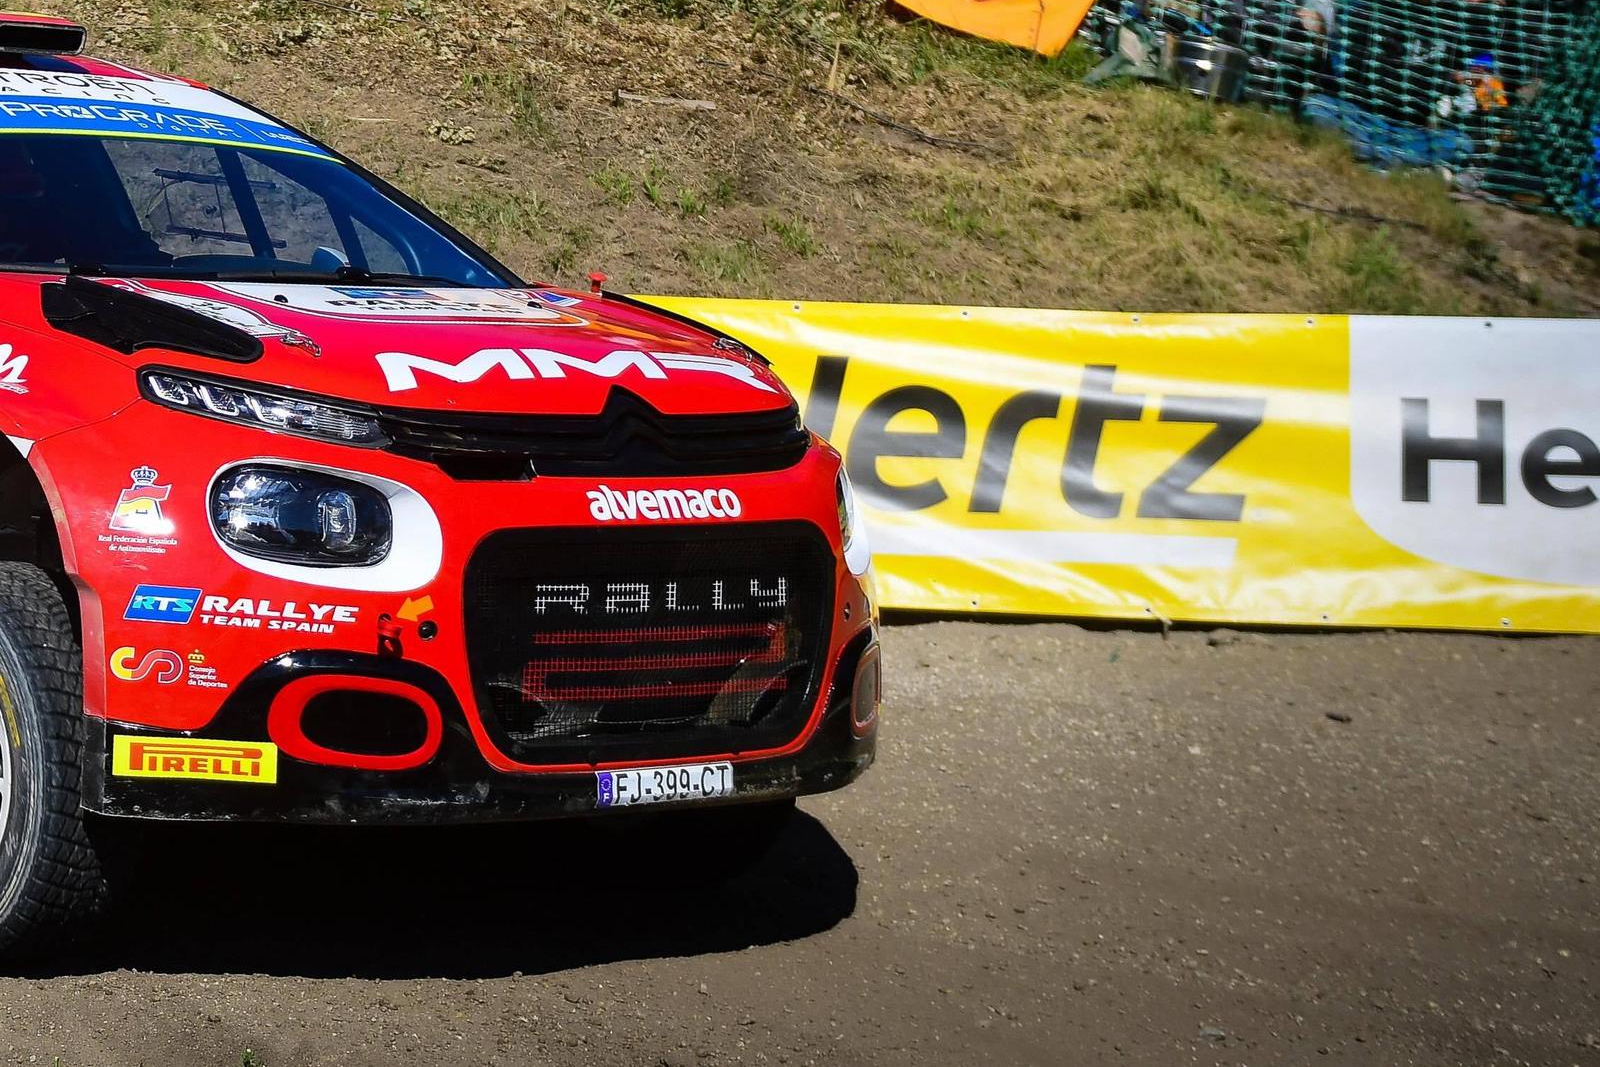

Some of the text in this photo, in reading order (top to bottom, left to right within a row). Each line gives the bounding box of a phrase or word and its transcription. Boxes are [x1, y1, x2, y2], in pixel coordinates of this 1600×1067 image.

[137, 122, 242, 139] DIGITAL
[376, 347, 779, 392] MMR
[586, 485, 742, 521] alvemaco
[131, 593, 359, 623] RTS RALLYE
[534, 577, 787, 615] RALLY
[199, 614, 335, 634] TEAM SPAIN
[188, 665, 216, 674] Consejo
[188, 672, 217, 682] Superior
[197, 679, 228, 689] Deportes
[129, 742, 263, 777] PIRELLI
[614, 764, 730, 807] FJ-399-CT
